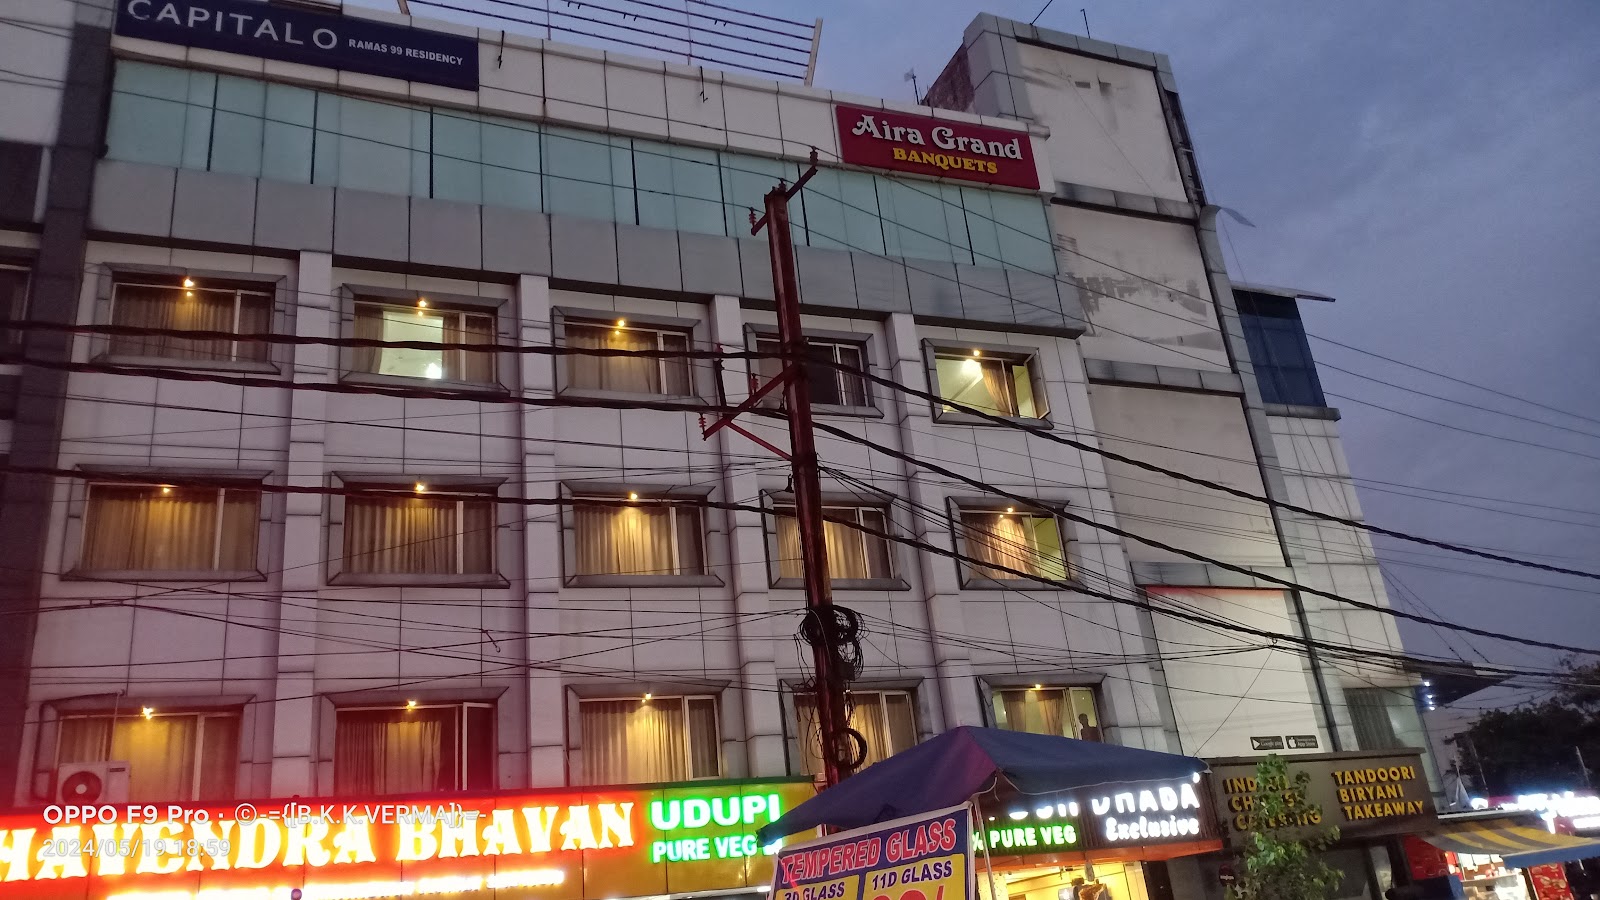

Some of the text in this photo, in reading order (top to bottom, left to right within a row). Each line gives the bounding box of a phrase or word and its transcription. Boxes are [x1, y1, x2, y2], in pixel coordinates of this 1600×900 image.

[348, 39, 463, 66] RAMAS 99 RESIDENCY
[852, 114, 1024, 160] Aira Grand
[892, 147, 998, 174] BANQUETS
[1334, 766, 1416, 785] TANDOORI
[1339, 783, 1404, 802] BIRYANI
[650, 793, 781, 831] UDUPI
[1344, 800, 1423, 820] TAKEAWAY
[395, 802, 635, 861] BHAVAN
[989, 827, 1038, 849] PURE
[1040, 825, 1077, 845] VEG
[1105, 815, 1200, 841] Exclusive
[653, 838, 711, 863] PURE
[714, 834, 758, 859] VEG
[780, 818, 957, 884] TEMPERED GLASS
[872, 860, 953, 891] 11D GLASS
[802, 881, 845, 900] GLASS
